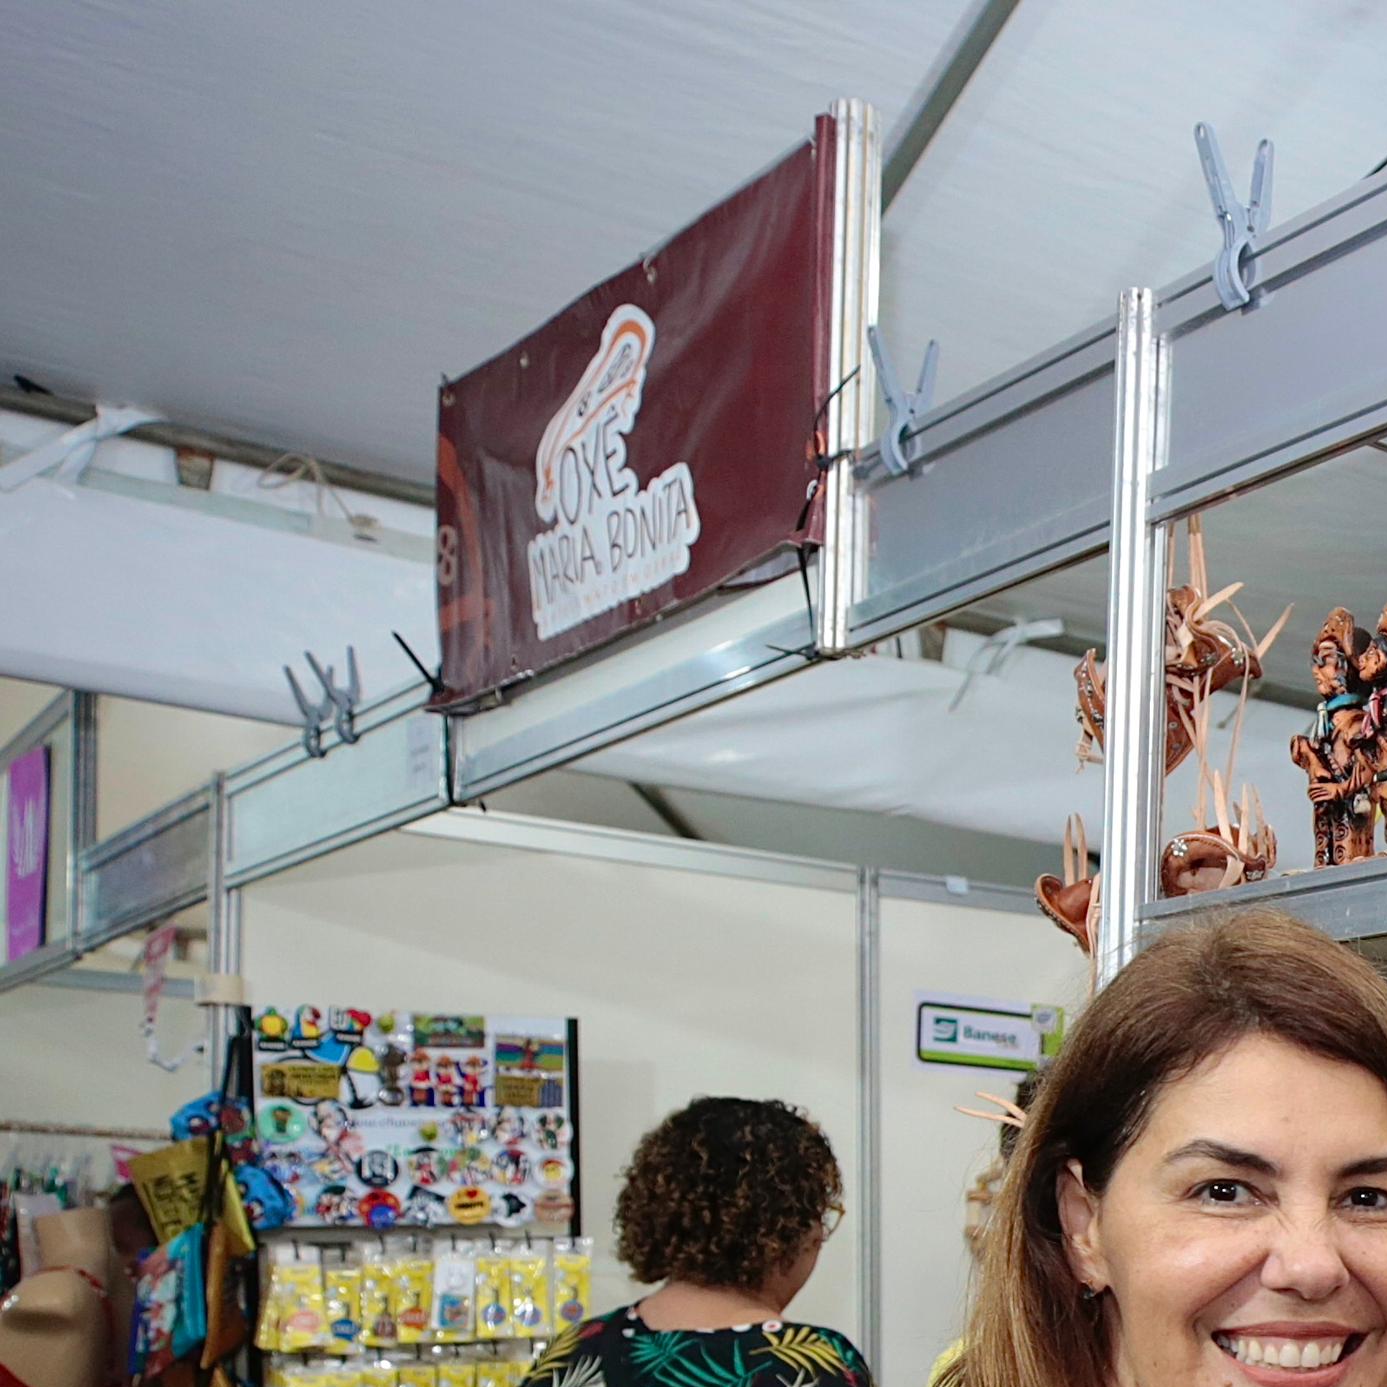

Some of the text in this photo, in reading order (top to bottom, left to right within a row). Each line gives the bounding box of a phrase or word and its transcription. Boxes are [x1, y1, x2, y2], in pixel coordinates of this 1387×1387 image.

[532, 525, 601, 606] MARIA
[607, 479, 691, 571] BONITA
[963, 1025, 1017, 1044] Banese
